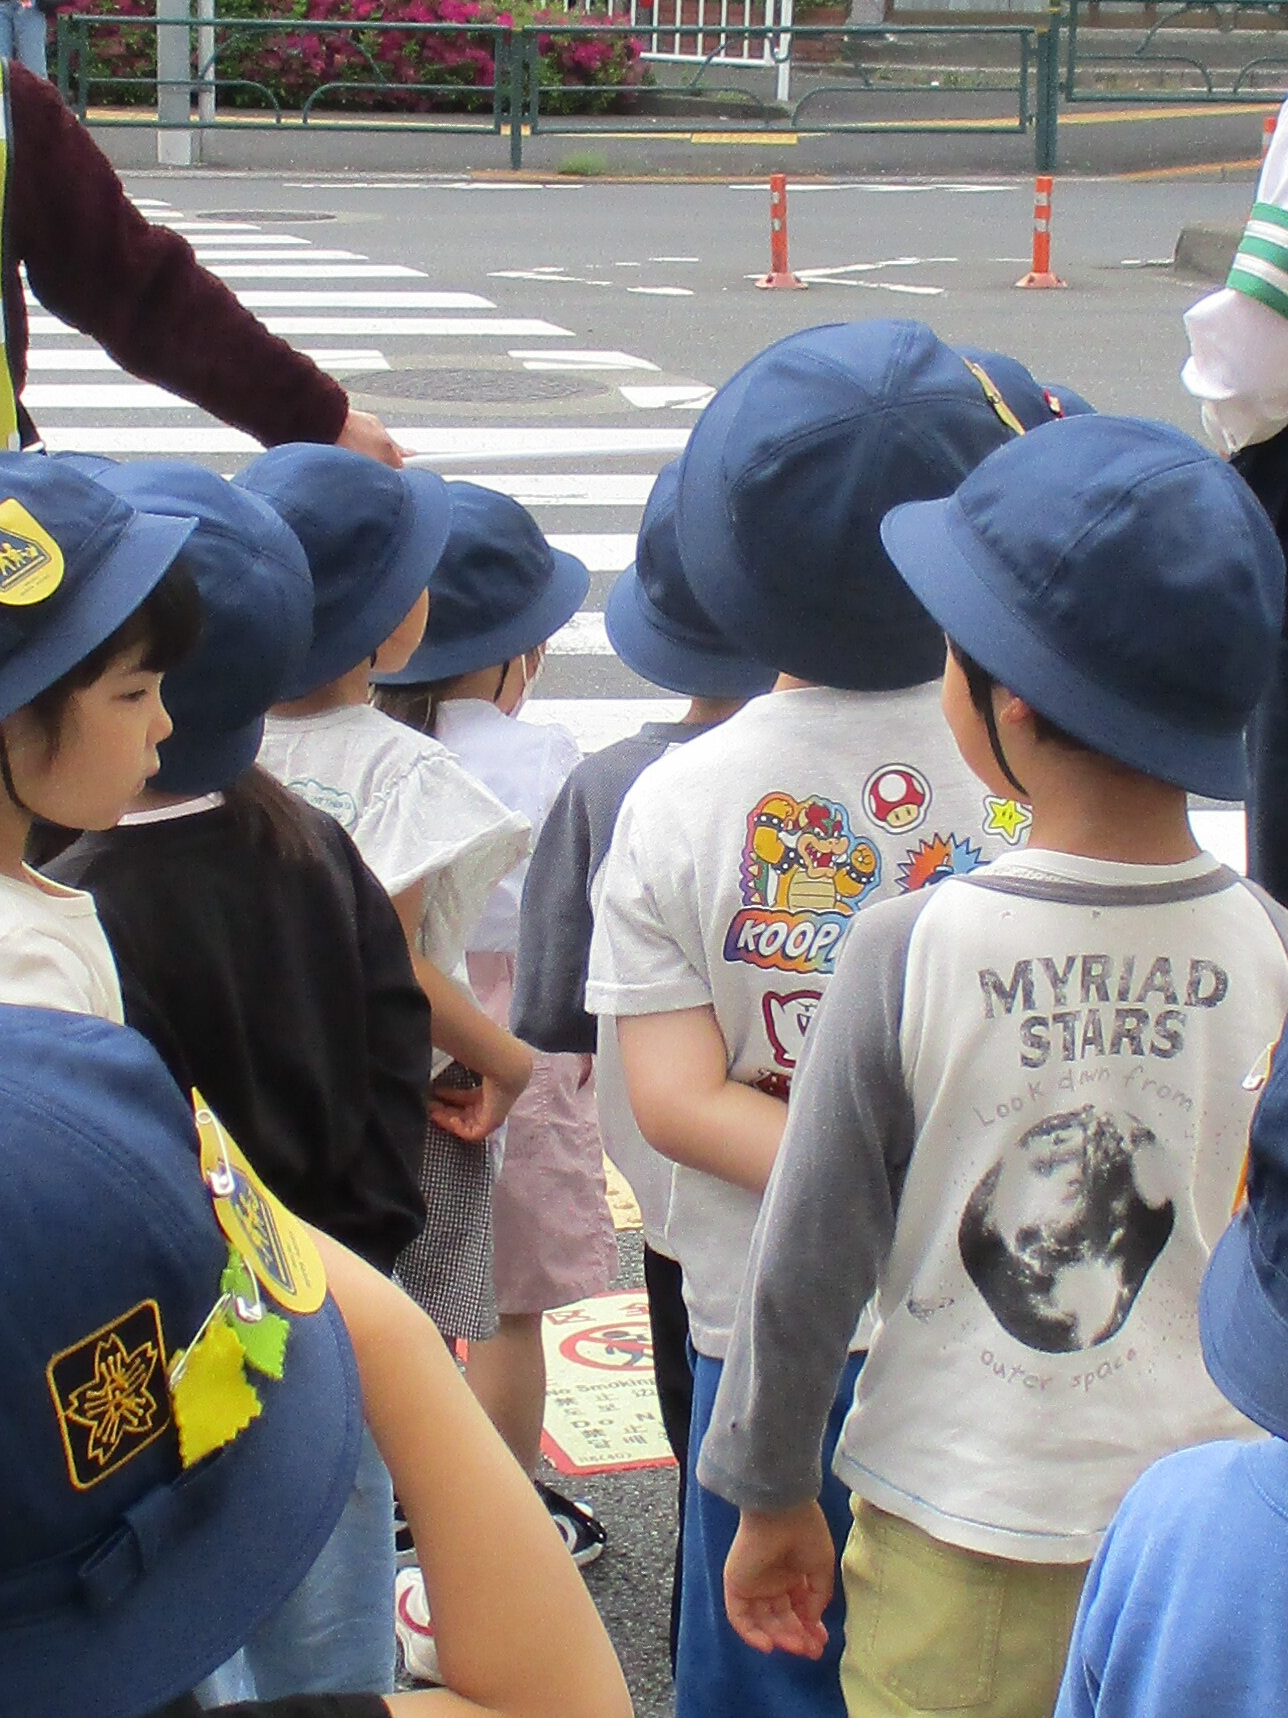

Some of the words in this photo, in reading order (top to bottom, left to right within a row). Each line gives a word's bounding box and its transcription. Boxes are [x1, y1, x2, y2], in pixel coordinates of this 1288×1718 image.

[978, 953, 1228, 1019] MYRIAD
[1019, 1008, 1187, 1068] STARS
[1123, 1064, 1194, 1113] from
[980, 1349, 1053, 1391] outer
